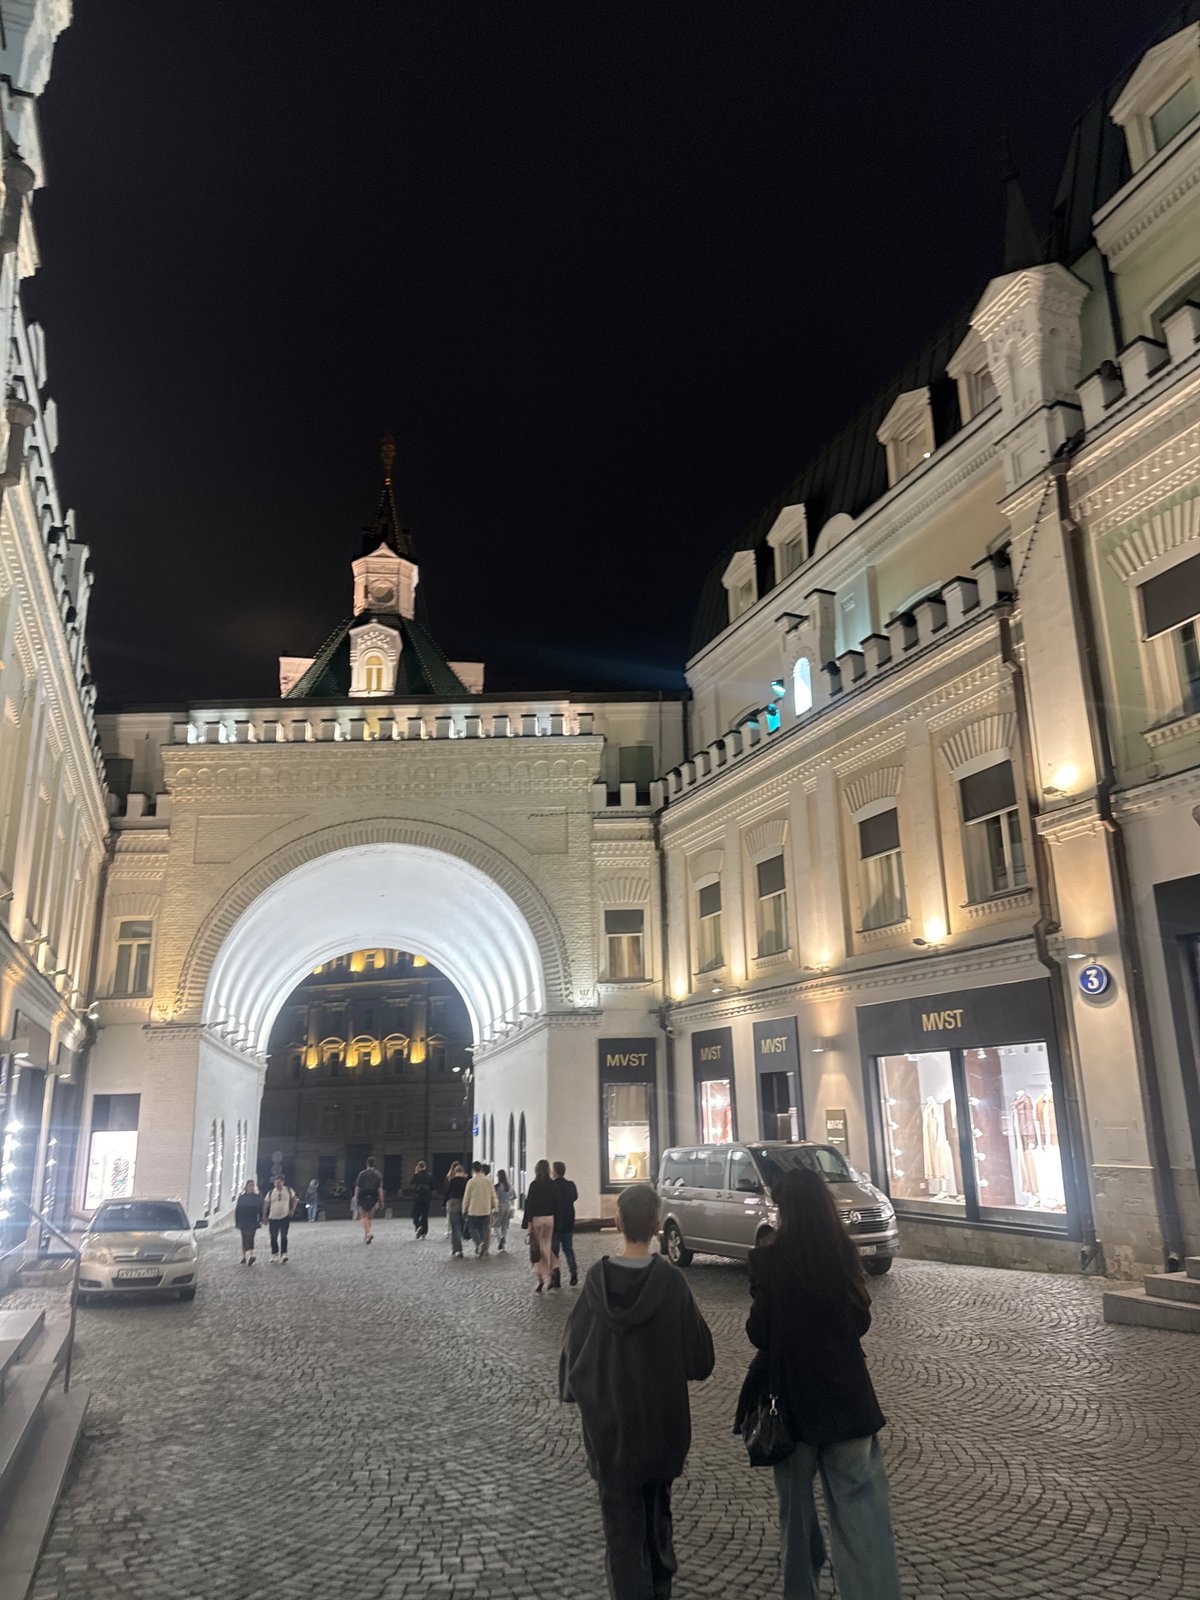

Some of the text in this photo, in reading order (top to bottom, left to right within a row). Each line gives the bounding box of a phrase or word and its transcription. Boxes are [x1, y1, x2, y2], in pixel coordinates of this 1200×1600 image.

[1085, 969, 1100, 990] 3
[921, 1009, 964, 1032] MVST
[700, 1045, 722, 1061] MVST
[761, 1036, 788, 1054] MVST
[606, 1053, 649, 1067] MVST
